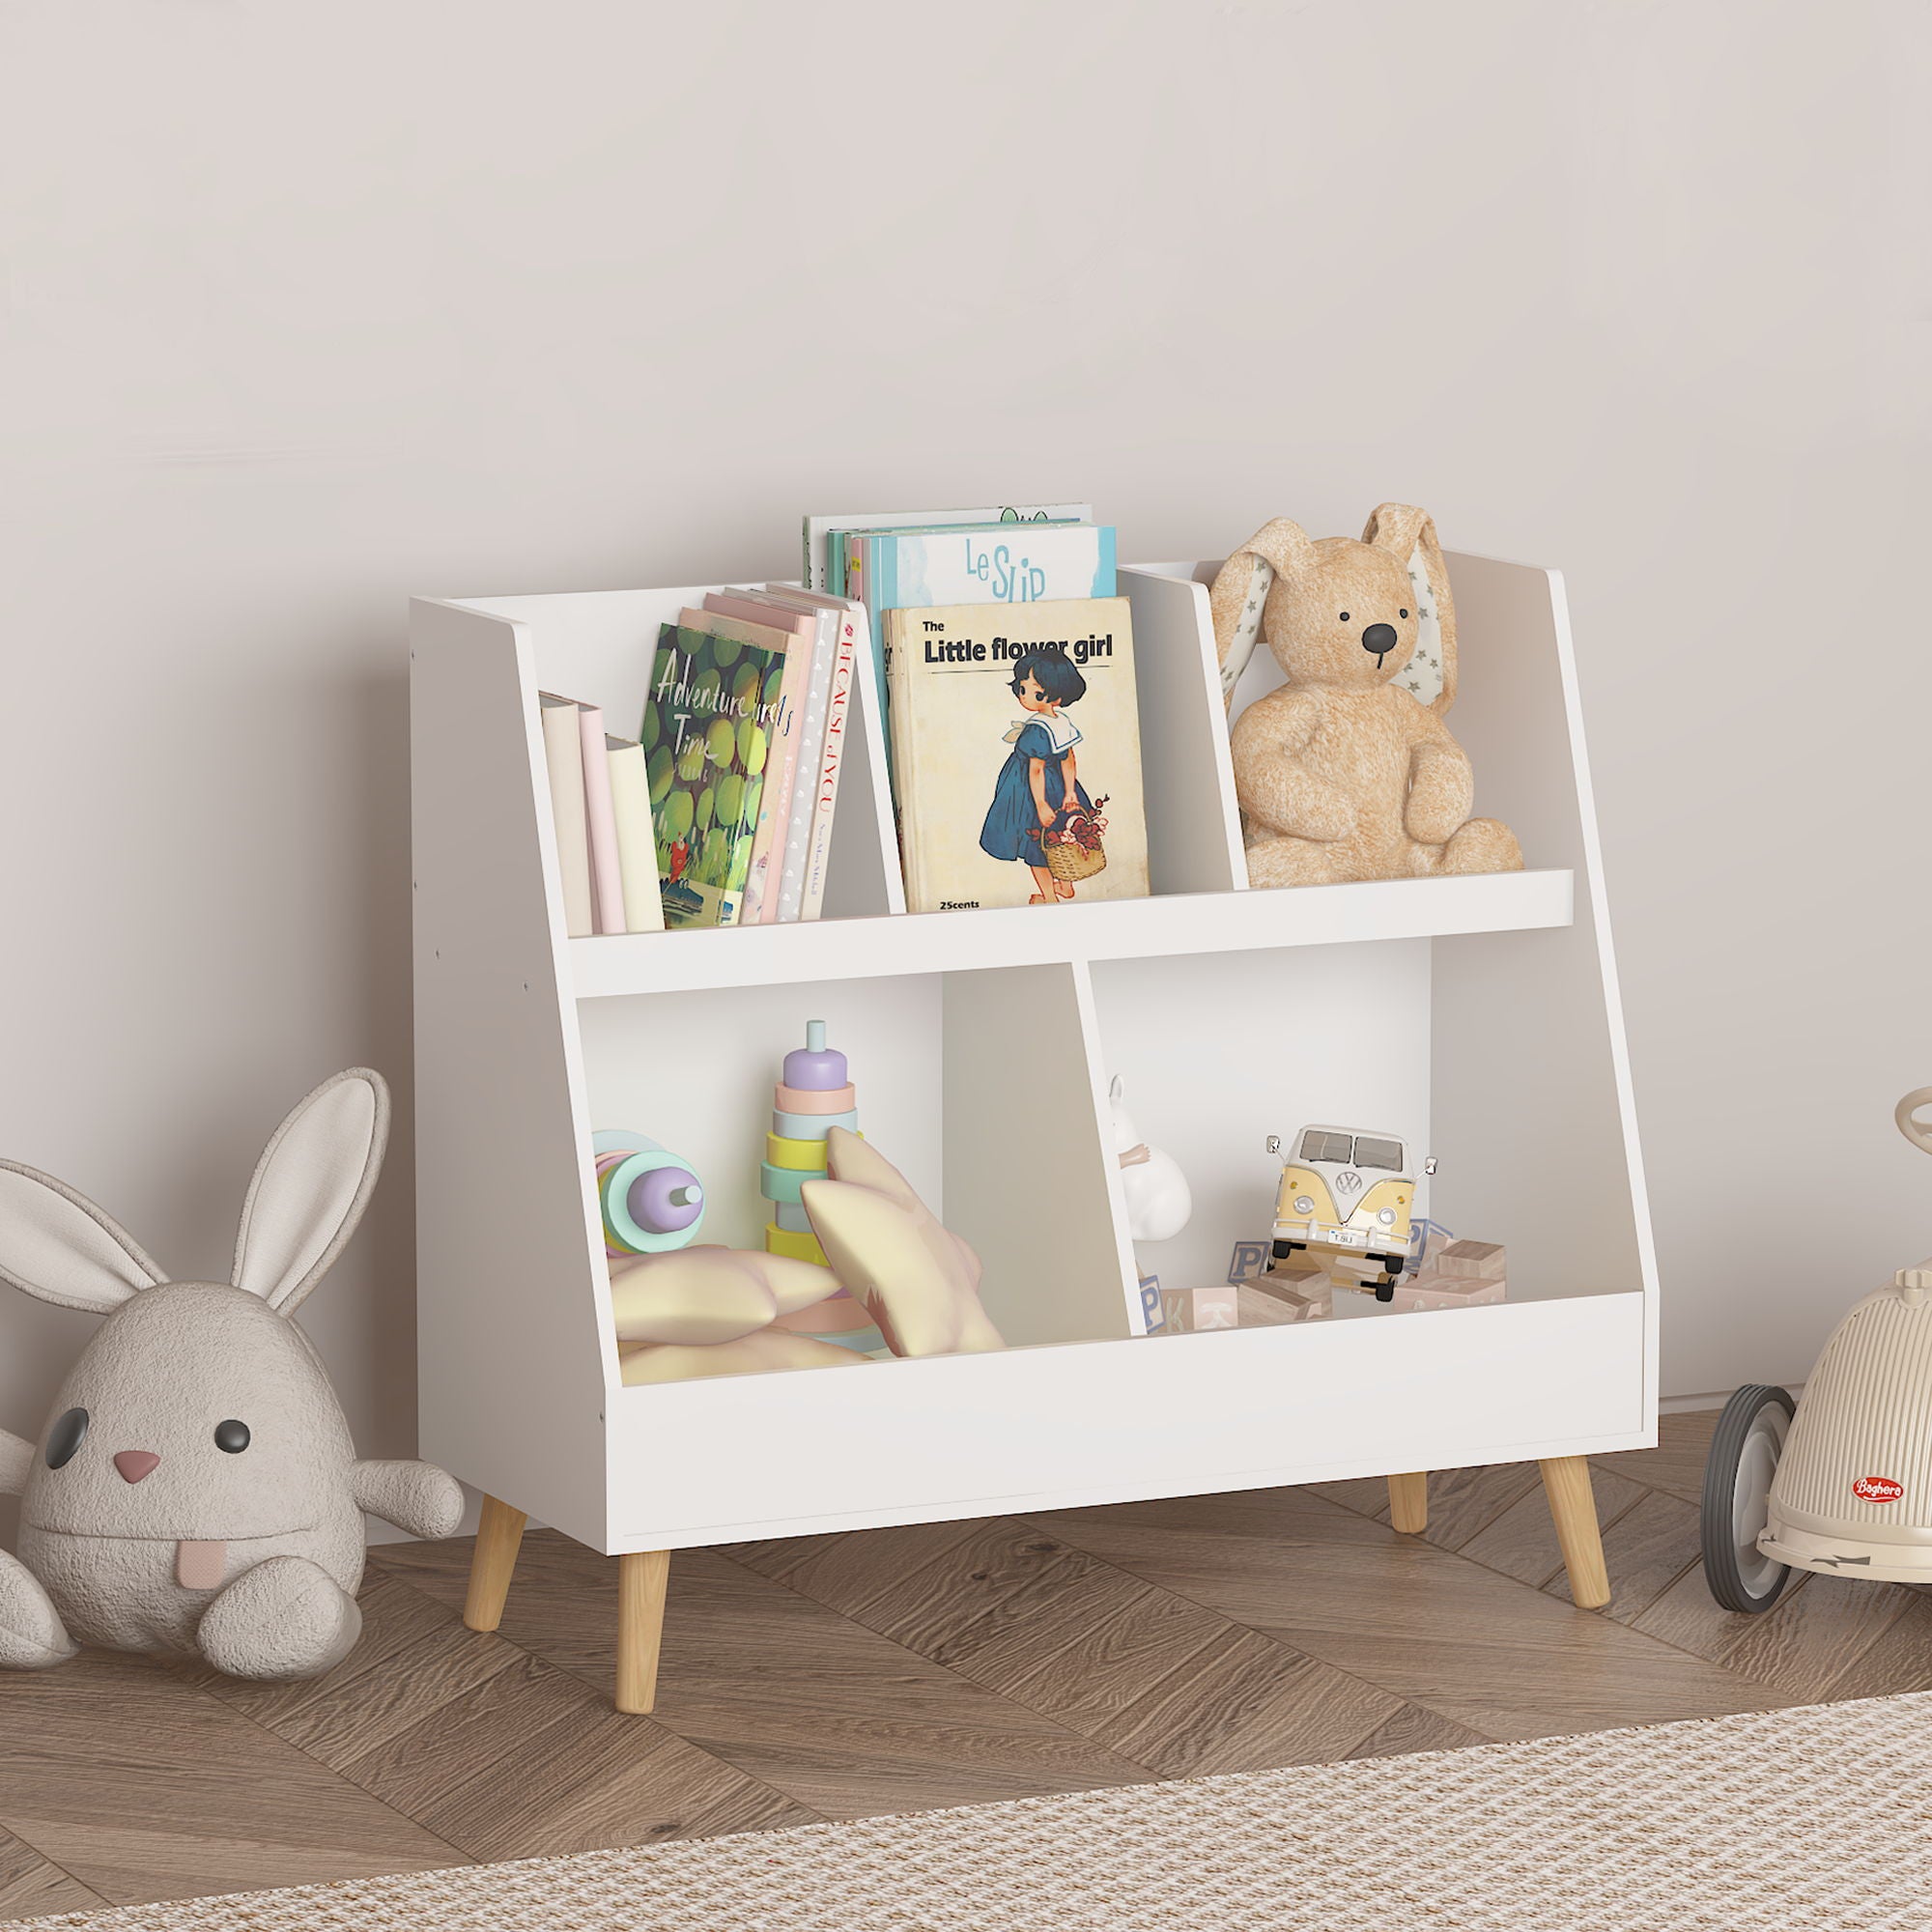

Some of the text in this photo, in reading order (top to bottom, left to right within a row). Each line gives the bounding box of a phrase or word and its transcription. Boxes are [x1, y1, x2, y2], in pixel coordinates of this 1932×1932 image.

[966, 538, 1046, 604] Le Slip
[923, 621, 945, 632] The
[924, 639, 986, 664] Little
[1073, 634, 1113, 664] girl
[657, 647, 749, 718] Adventure
[830, 639, 853, 736] BECAUSE
[673, 713, 720, 760] Time
[819, 762, 838, 813] YOU
[940, 900, 980, 910] 25cents
[1856, 1478, 1901, 1497] Baghera
